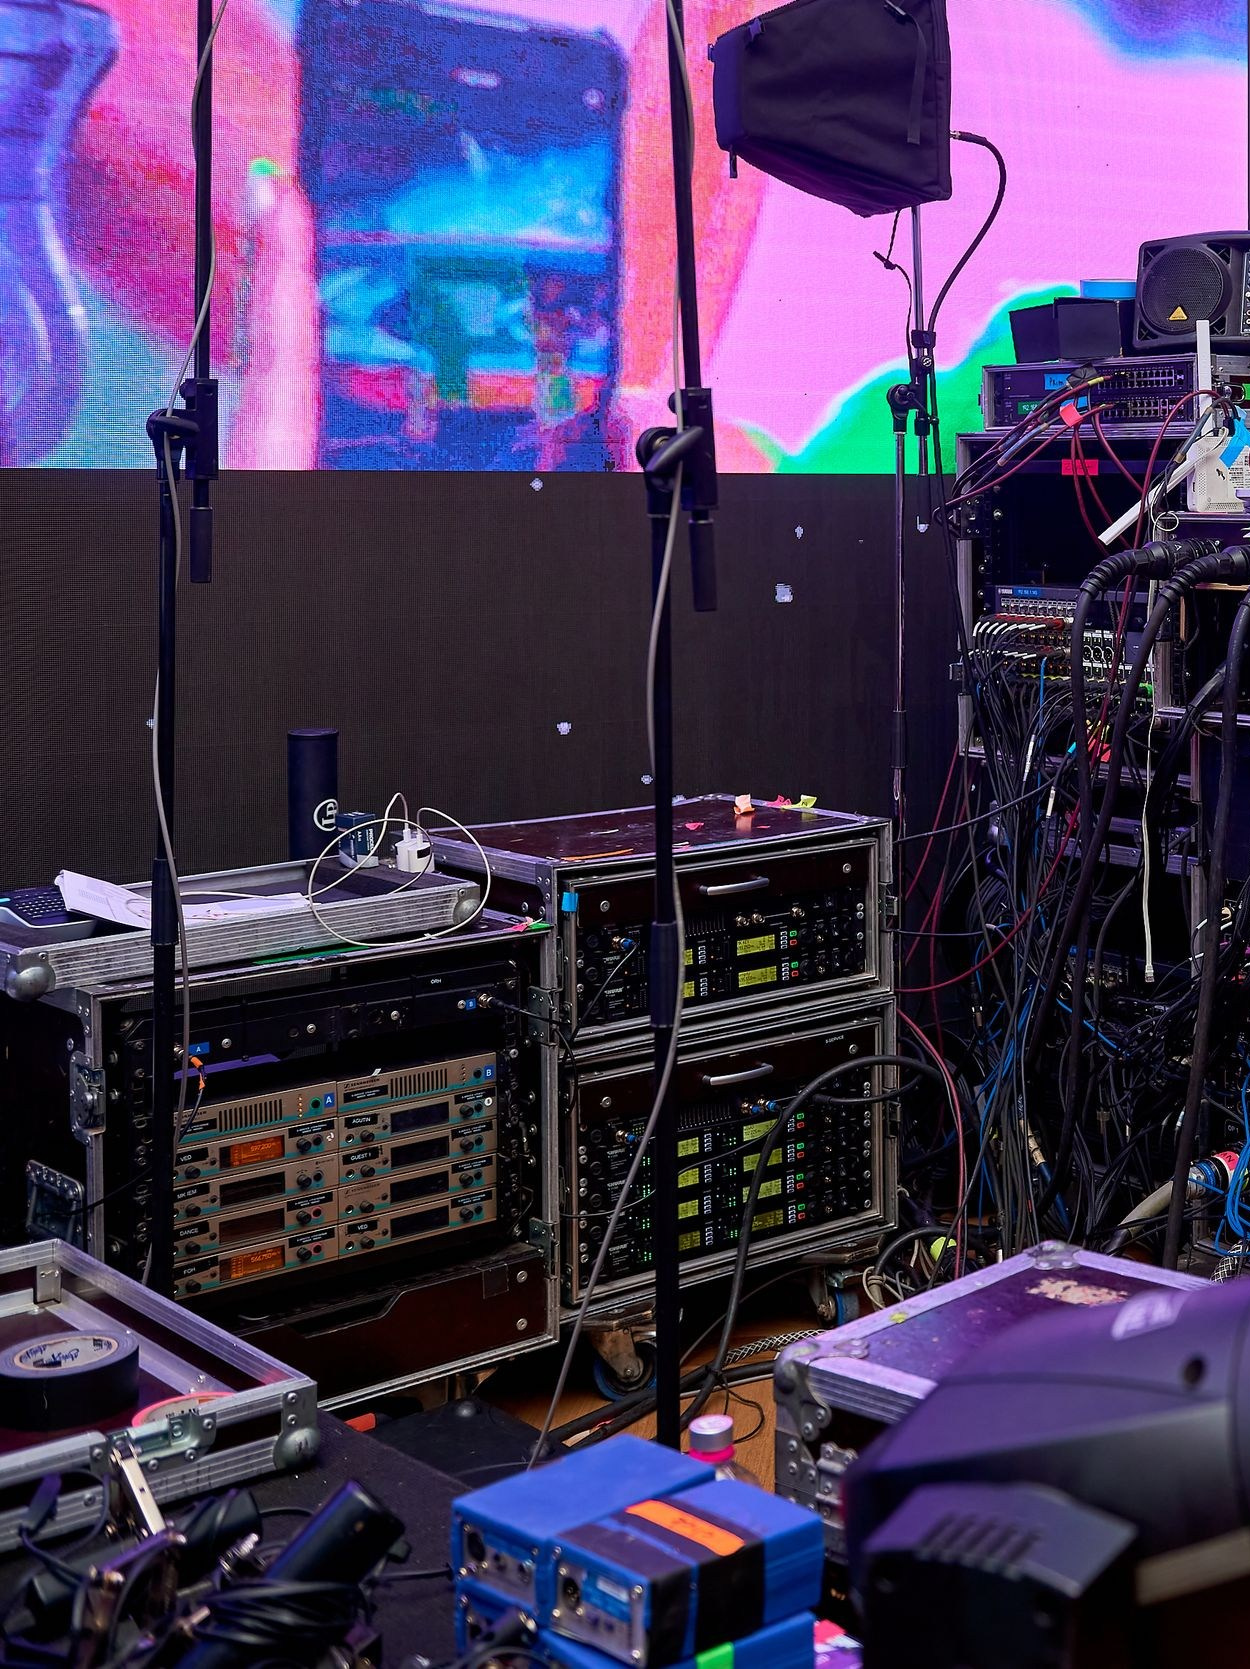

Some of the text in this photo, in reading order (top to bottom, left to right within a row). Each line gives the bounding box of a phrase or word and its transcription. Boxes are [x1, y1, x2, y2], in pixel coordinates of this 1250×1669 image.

[325, 1096, 332, 1104] A
[350, 1153, 367, 1162] GUEST
[357, 1223, 368, 1231] VED
[179, 1227, 199, 1237] DANCE
[183, 1267, 196, 1276] FOH
